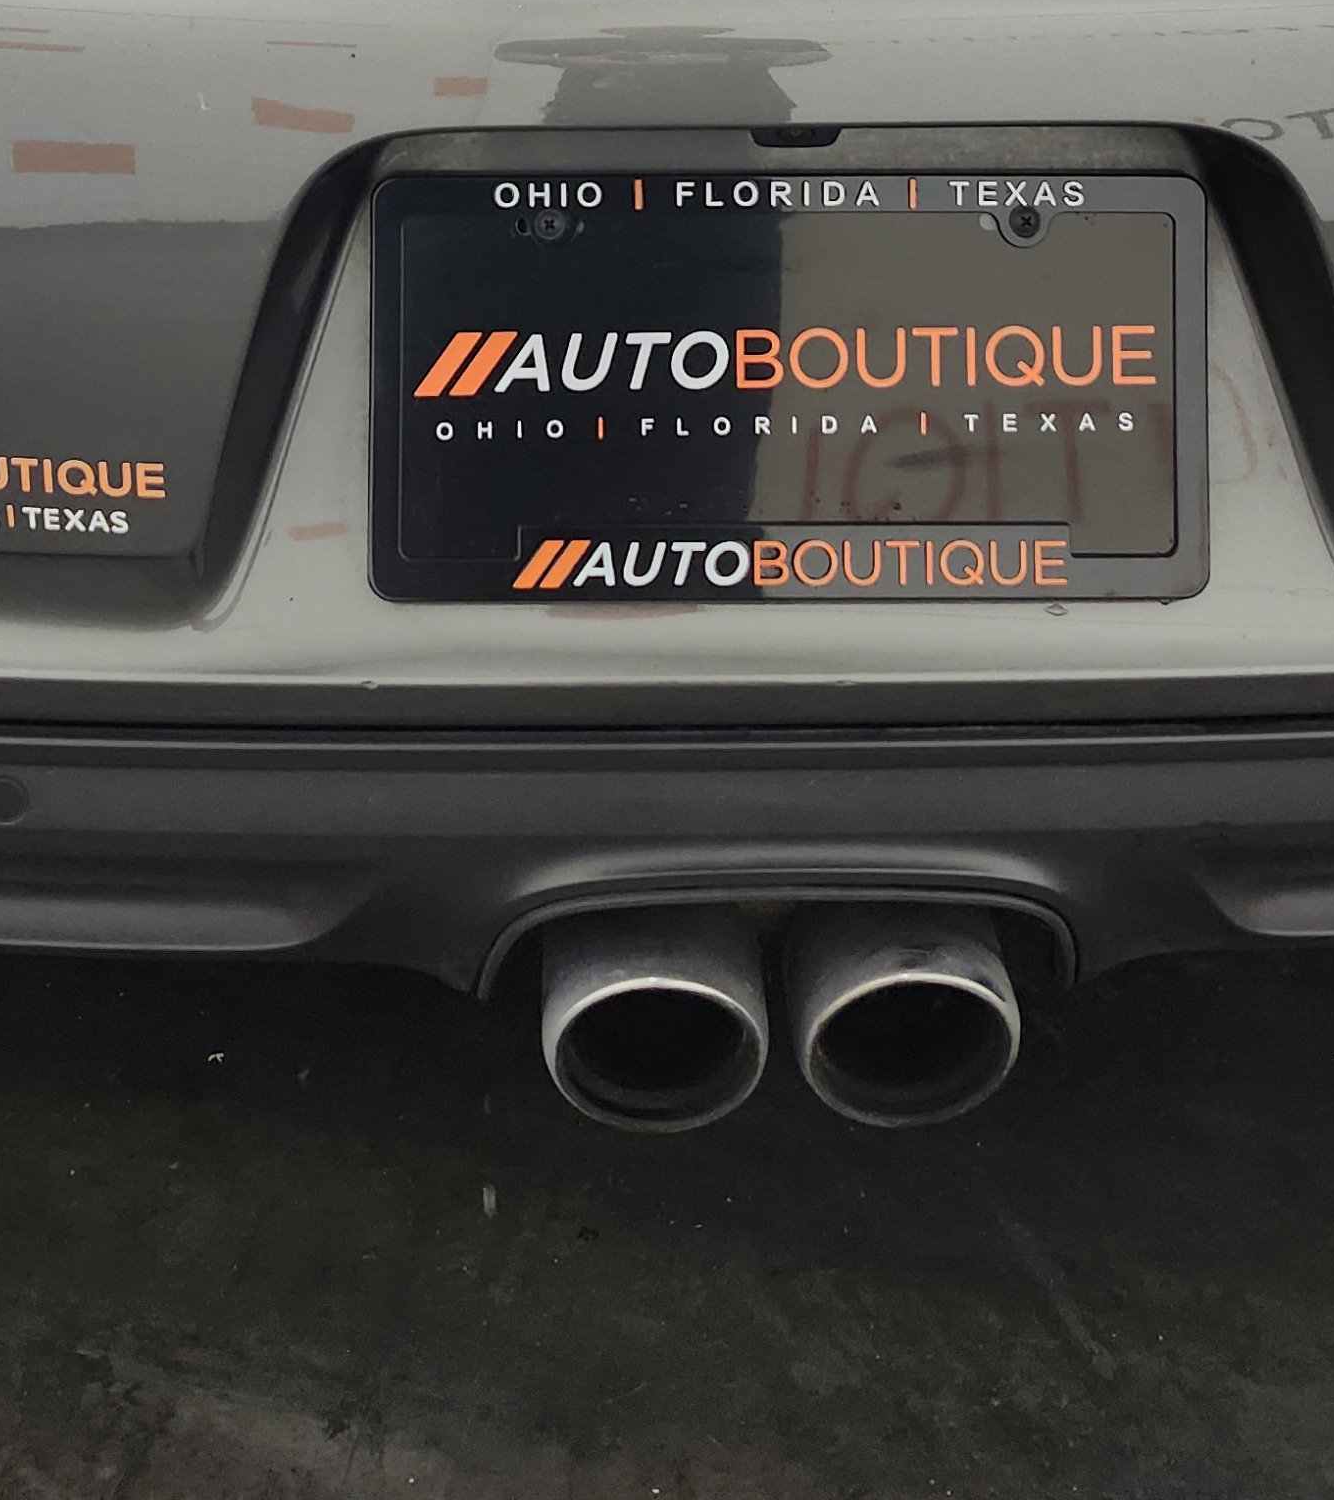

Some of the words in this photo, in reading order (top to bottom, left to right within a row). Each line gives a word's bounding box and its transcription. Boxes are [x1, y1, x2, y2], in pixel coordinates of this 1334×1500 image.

[493, 181, 604, 209] OHIO
[675, 180, 881, 208] FLORIDA
[949, 180, 1087, 208] TEXAS
[435, 418, 565, 441] OHIO
[639, 415, 879, 438] FLORIDA
[962, 411, 1137, 434] TEXAS
[23, 506, 130, 534] TEXAS
